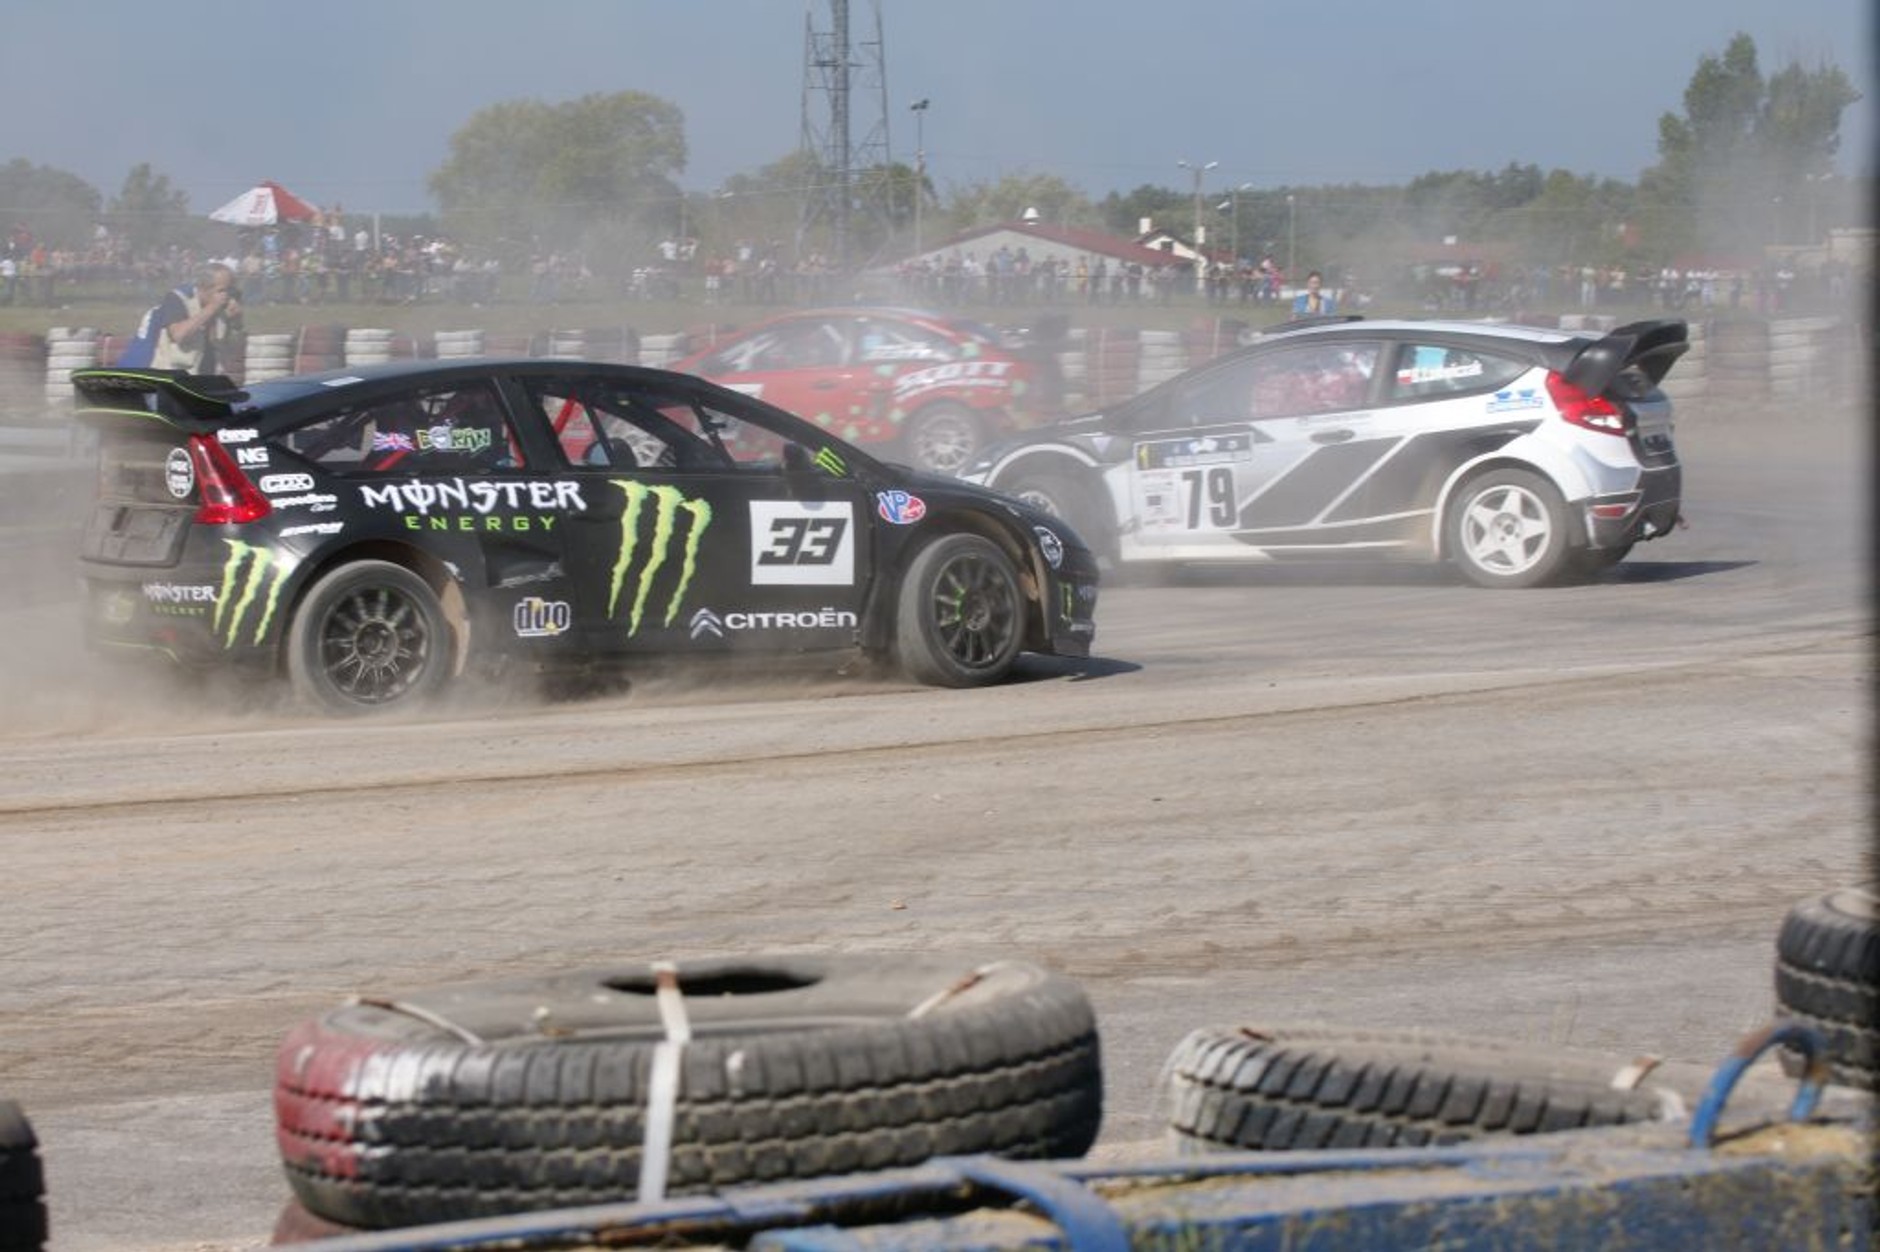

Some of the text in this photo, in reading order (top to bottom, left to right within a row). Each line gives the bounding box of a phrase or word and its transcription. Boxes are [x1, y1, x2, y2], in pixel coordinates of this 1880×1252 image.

[238, 447, 269, 464] NG
[359, 477, 588, 515] MONSTER
[1181, 467, 1238, 530] 79
[404, 515, 555, 531] ENERGY
[757, 518, 848, 565] 33
[516, 598, 570, 635] duo
[725, 607, 858, 630] CITROËN
